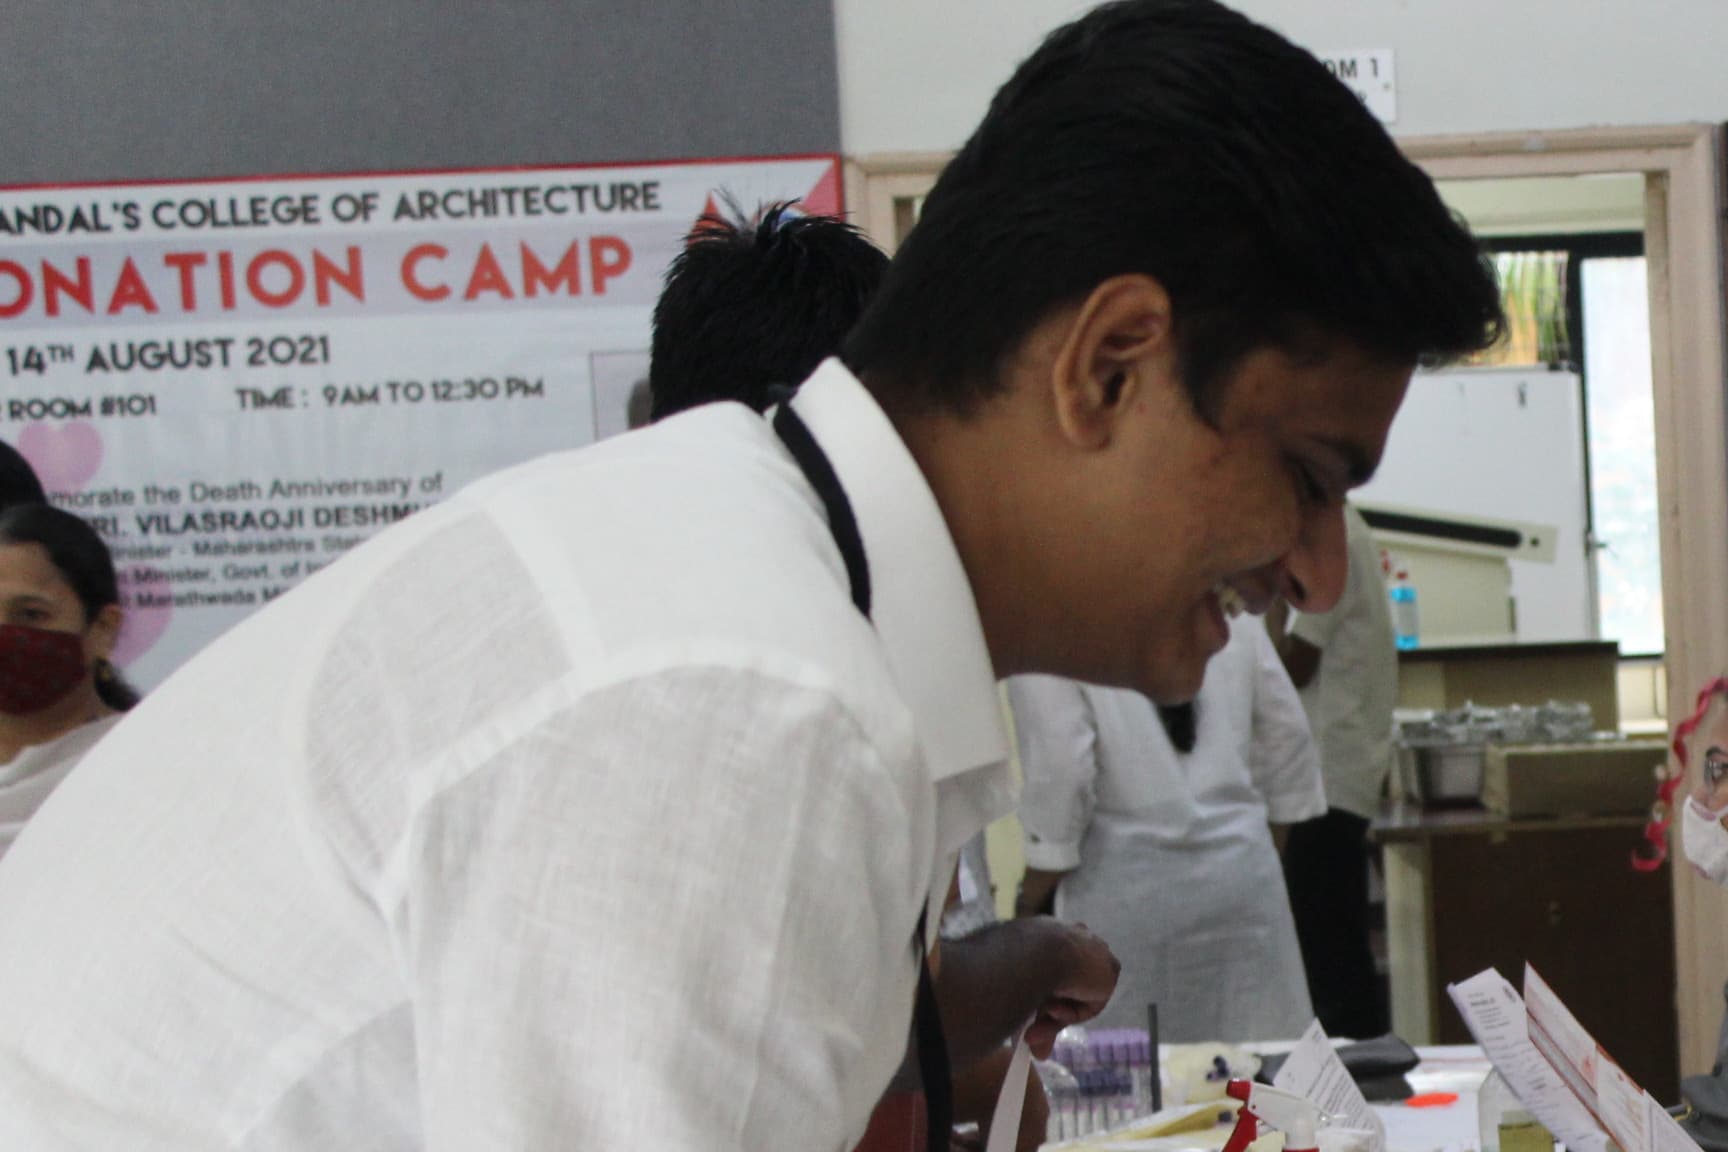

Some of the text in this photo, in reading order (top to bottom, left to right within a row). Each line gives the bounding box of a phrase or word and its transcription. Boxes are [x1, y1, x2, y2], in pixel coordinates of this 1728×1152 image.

[152, 195, 320, 229] COLLEGE
[331, 192, 379, 223] OF
[393, 181, 660, 221] ARCHITECTURE
[400, 234, 633, 302] CAMP
[86, 337, 235, 374] AUGUST
[246, 334, 331, 368] 2021
[9, 394, 157, 421] ROOM #101
[235, 386, 295, 410] TIME
[323, 384, 380, 407] 9AM
[387, 380, 425, 403] TO
[431, 377, 499, 402] 12:30
[504, 376, 545, 399] PM
[144, 484, 181, 501] the
[190, 479, 262, 501] Death
[270, 475, 411, 498] Anniversary
[420, 470, 443, 493] of
[135, 508, 304, 536] VILASRAOJI
